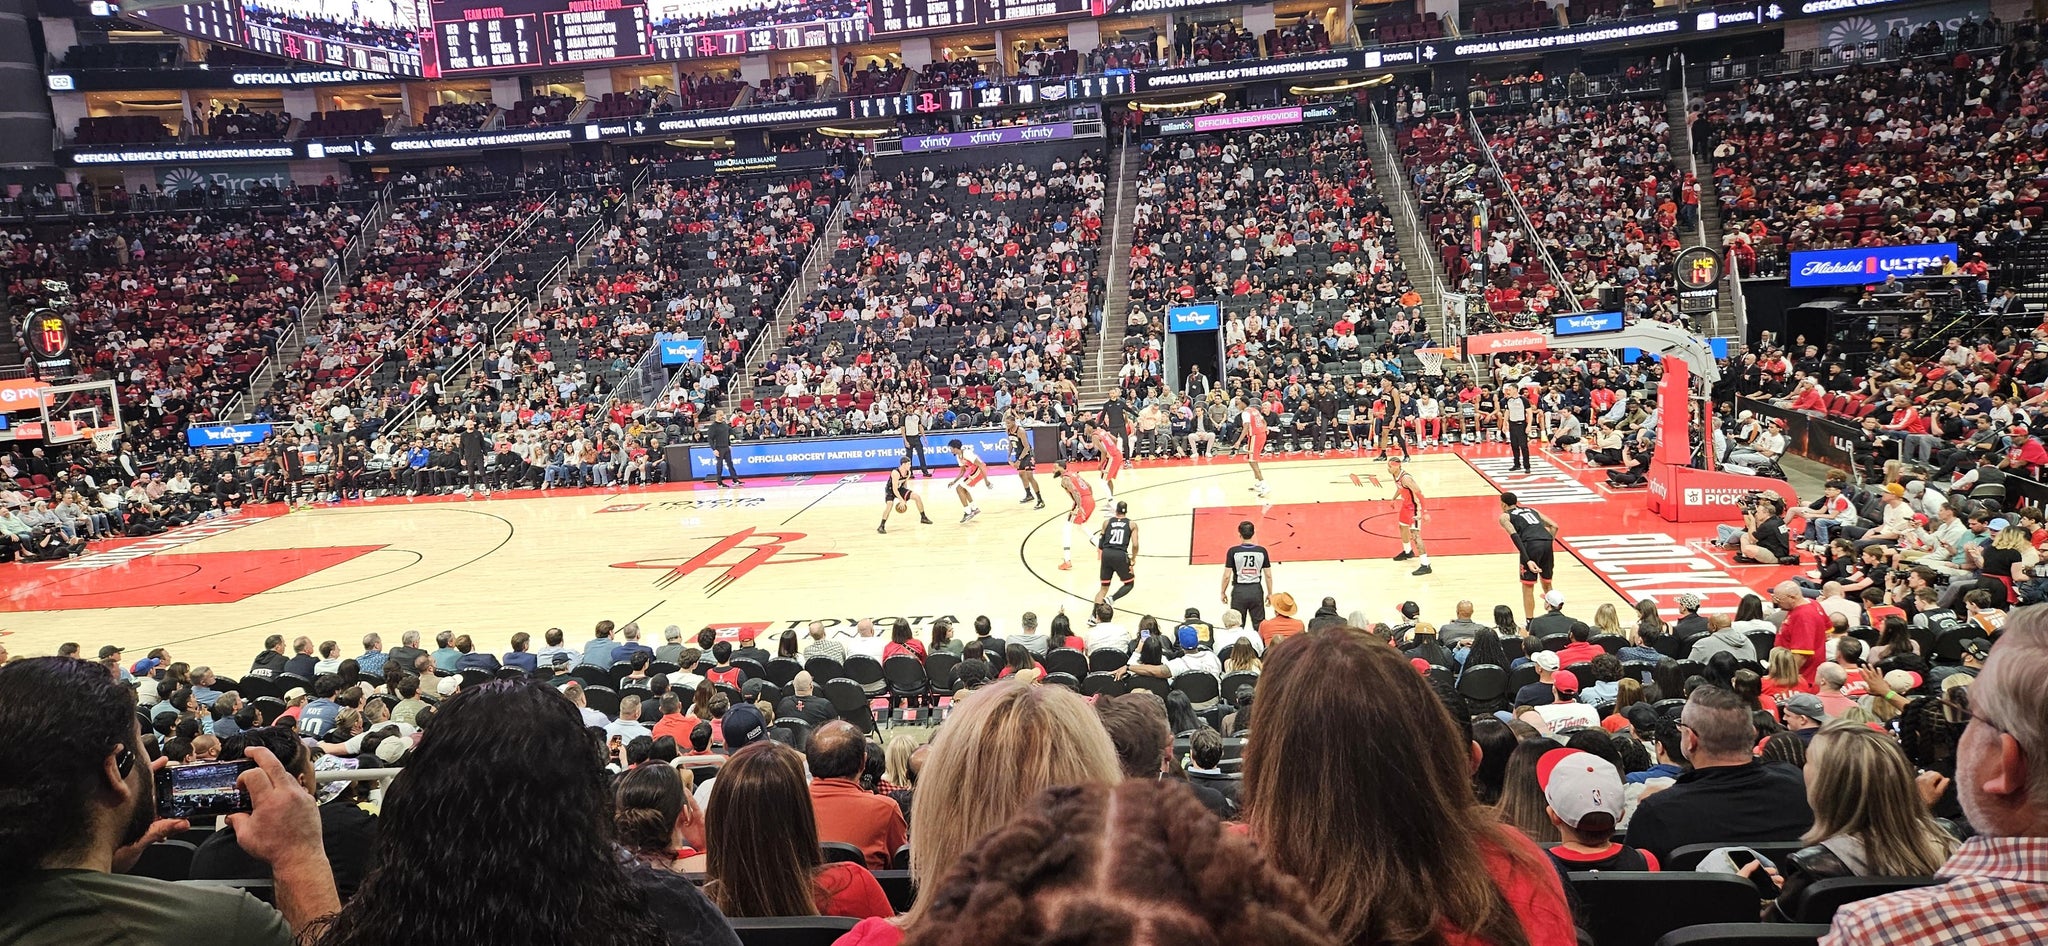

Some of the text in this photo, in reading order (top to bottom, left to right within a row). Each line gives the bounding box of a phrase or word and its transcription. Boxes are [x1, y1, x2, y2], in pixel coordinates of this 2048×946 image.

[463, 9, 482, 20] TEAM
[1718, 11, 1755, 24] TOYOTA
[582, 22, 616, 35] THOMPSON
[724, 34, 736, 53] 77
[750, 31, 771, 46] 1:42
[784, 28, 799, 48] 70
[1455, 21, 1679, 55] OFFICIAL VEHICLE OF THE HOUSTON ROCKETS
[304, 40, 316, 60] 77
[353, 49, 367, 69] 70
[1383, 52, 1413, 62] TOYOTA
[233, 73, 291, 84] OFFICIAL
[290, 71, 342, 83] VEHICLE
[342, 70, 360, 81] OF
[1149, 58, 1348, 86] OFFICIAL VEHICLE OF THE HOUSTON ROCKETS
[949, 85, 1033, 109] 77 1:42 70
[659, 107, 838, 130] OFFICIAL VEHICLE OF THE HOUSTON ROCKETS
[1198, 111, 1298, 128] OFFICIAL ENERGY PROVIDER
[1303, 107, 1328, 118] reliant
[600, 126, 626, 135] TOYOTA
[1021, 126, 1053, 139] xfinity
[1161, 121, 1185, 132] reliant
[391, 130, 572, 150] OFFICIAL VEHICLE OF THE HOUSTON ROCKETS
[920, 136, 951, 148] xfinity
[970, 131, 1002, 144] xfinity
[74, 148, 293, 163] OFFICIAL VEHICLE OF THE HOUSTON ROCKETS
[325, 145, 354, 153] TOYOTA
[714, 156, 775, 167] MEMORIAL HERMANN
[1801, 256, 1942, 276] Michelob ULTRA
[1693, 269, 1711, 283] 14
[1691, 289, 1718, 297] TISSOT
[1581, 316, 1608, 330] Kroger
[44, 331, 62, 351] 14
[47, 359, 70, 367] TISSOT
[221, 427, 253, 443] Kroger
[748, 447, 935, 464] OFFICIAL GROCERY PARTNER OF THE HOON
[1649, 477, 1667, 500] xfinity
[660, 498, 765, 506] TOYOTA
[1705, 494, 1745, 505] PICK
[1520, 512, 1540, 525] 10
[1109, 529, 1124, 544] 20
[1243, 555, 1255, 567] 73
[1562, 533, 1775, 626] ROCKET
[785, 615, 960, 629] TOYOTA
[300, 718, 322, 735] 10
